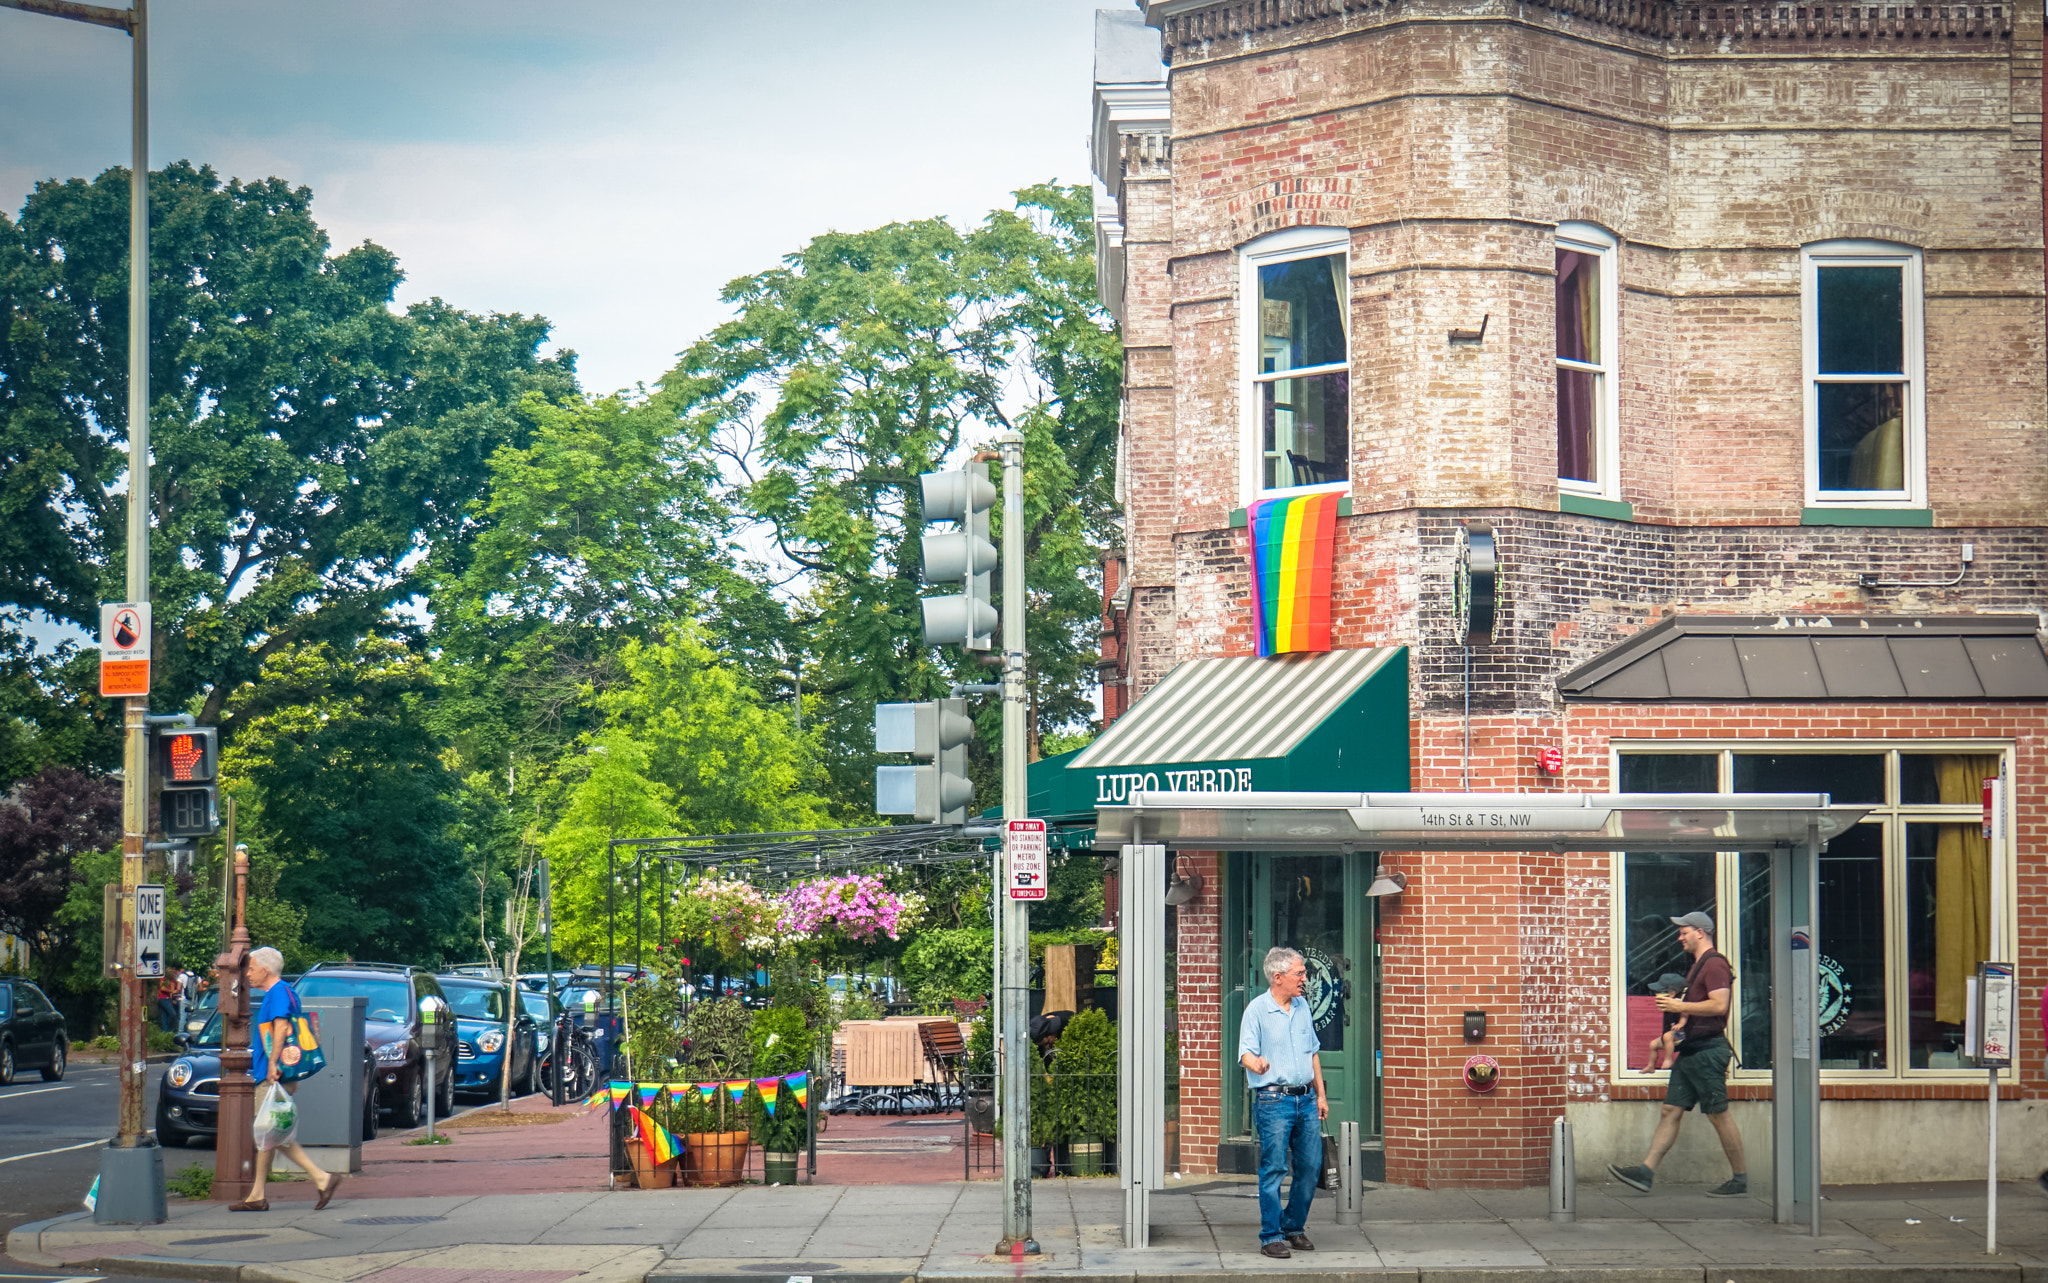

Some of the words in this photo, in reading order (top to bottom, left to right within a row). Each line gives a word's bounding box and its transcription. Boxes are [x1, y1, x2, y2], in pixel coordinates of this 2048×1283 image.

[1096, 773, 1159, 802] LUPO
[1166, 768, 1252, 792] VERDE
[1422, 814, 1445, 826] 14th
[1449, 814, 1461, 826] St
[1466, 814, 1474, 826] &
[1478, 814, 1486, 826] T
[1490, 814, 1506, 828] St,
[1510, 814, 1531, 826] NW
[140, 893, 161, 914] ONE
[139, 919, 161, 940] WAY
[1305, 947, 1333, 969] VERDE
[1321, 1009, 1335, 1028] BAR
[1826, 1015, 1847, 1035] BAR
